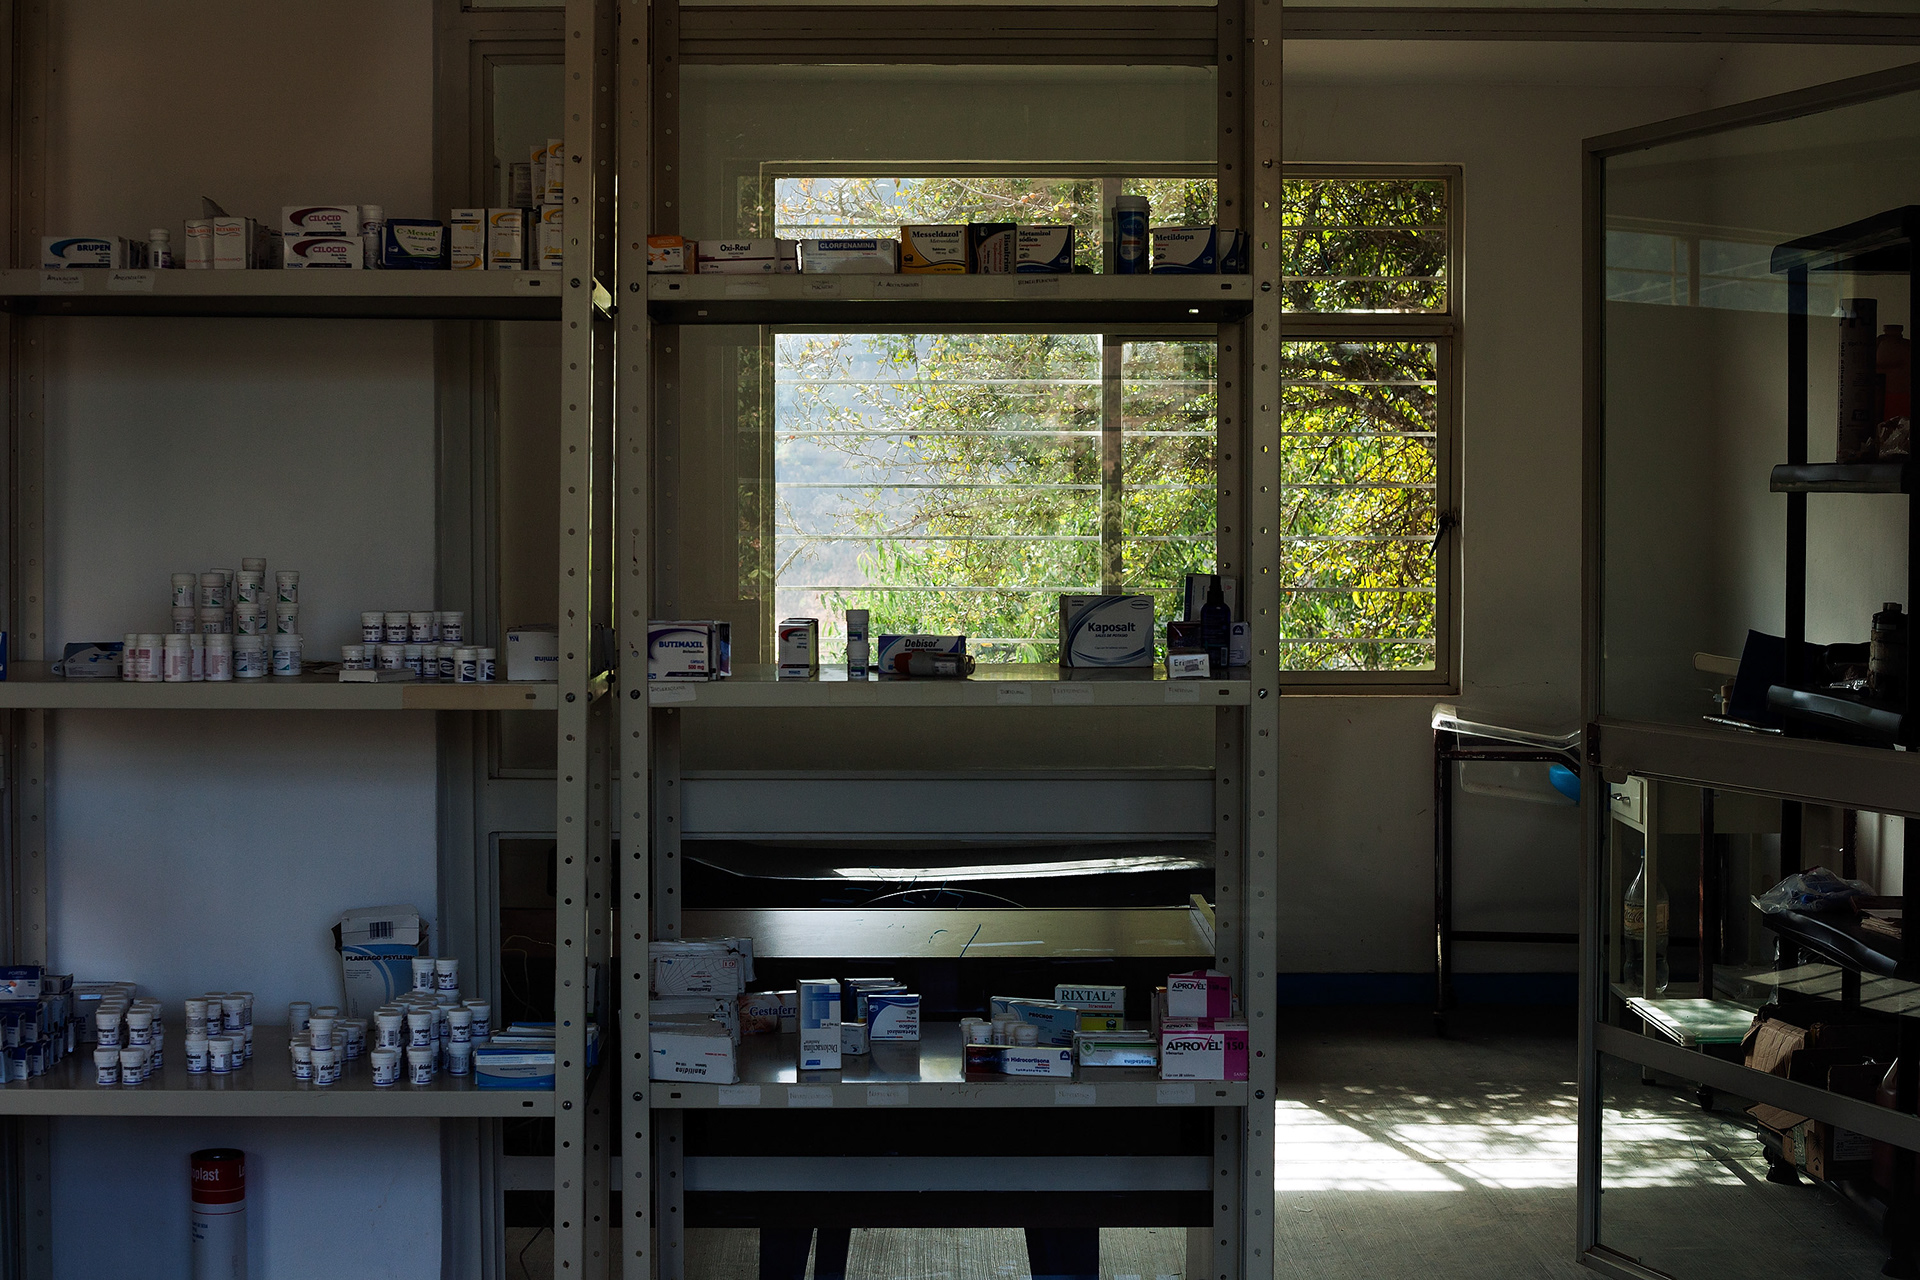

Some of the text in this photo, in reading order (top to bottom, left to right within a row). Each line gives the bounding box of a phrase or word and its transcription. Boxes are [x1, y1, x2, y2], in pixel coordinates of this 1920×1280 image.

[396, 228, 437, 237] C-Messel
[911, 230, 959, 238] Messeldazol
[1155, 233, 1194, 242] Metildopa
[720, 244, 751, 252] Oxi-Reul
[1088, 622, 1136, 633] Kaposalt
[905, 639, 939, 648] Debisor
[1171, 981, 1206, 990] APROVEL
[1165, 1038, 1222, 1051] APROVEL
[1226, 1042, 1244, 1051] 150
[1010, 1057, 1050, 1065] Hidrocortisona
[1124, 1058, 1152, 1066] loratadina
[675, 1066, 707, 1075] Ranitidina
